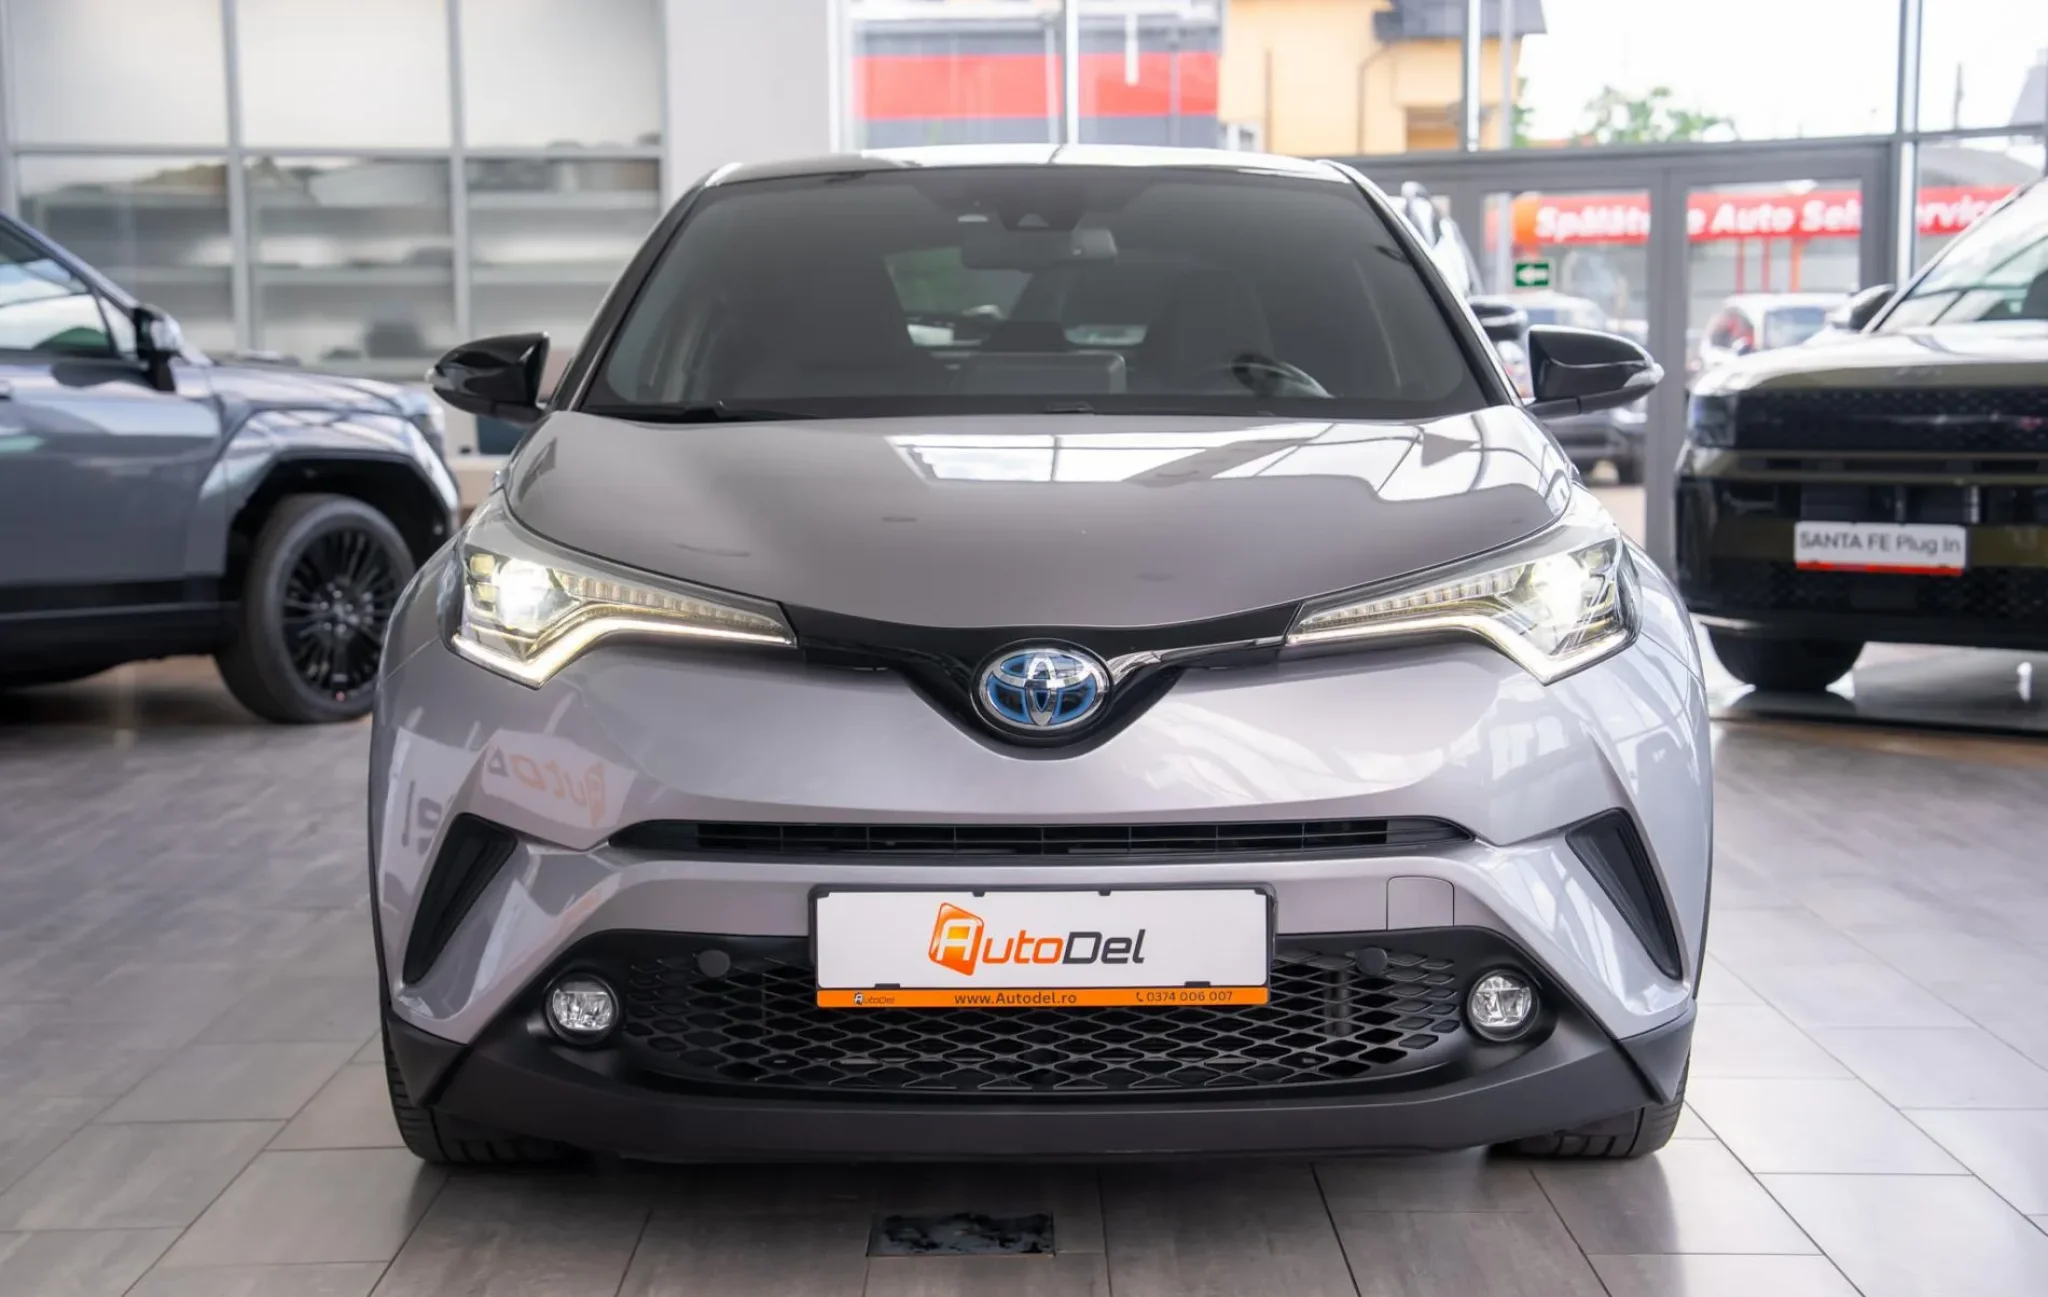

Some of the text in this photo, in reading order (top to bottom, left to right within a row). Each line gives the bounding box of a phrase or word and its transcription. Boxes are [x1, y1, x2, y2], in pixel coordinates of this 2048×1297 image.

[1710, 203, 1795, 234] Auto
[1800, 531, 1961, 554] SANTA FE Plug In
[931, 907, 1146, 971] AutoDel
[955, 992, 1077, 1005] www.Autodel.ro
[1147, 991, 1233, 1002] 0374 006 007
